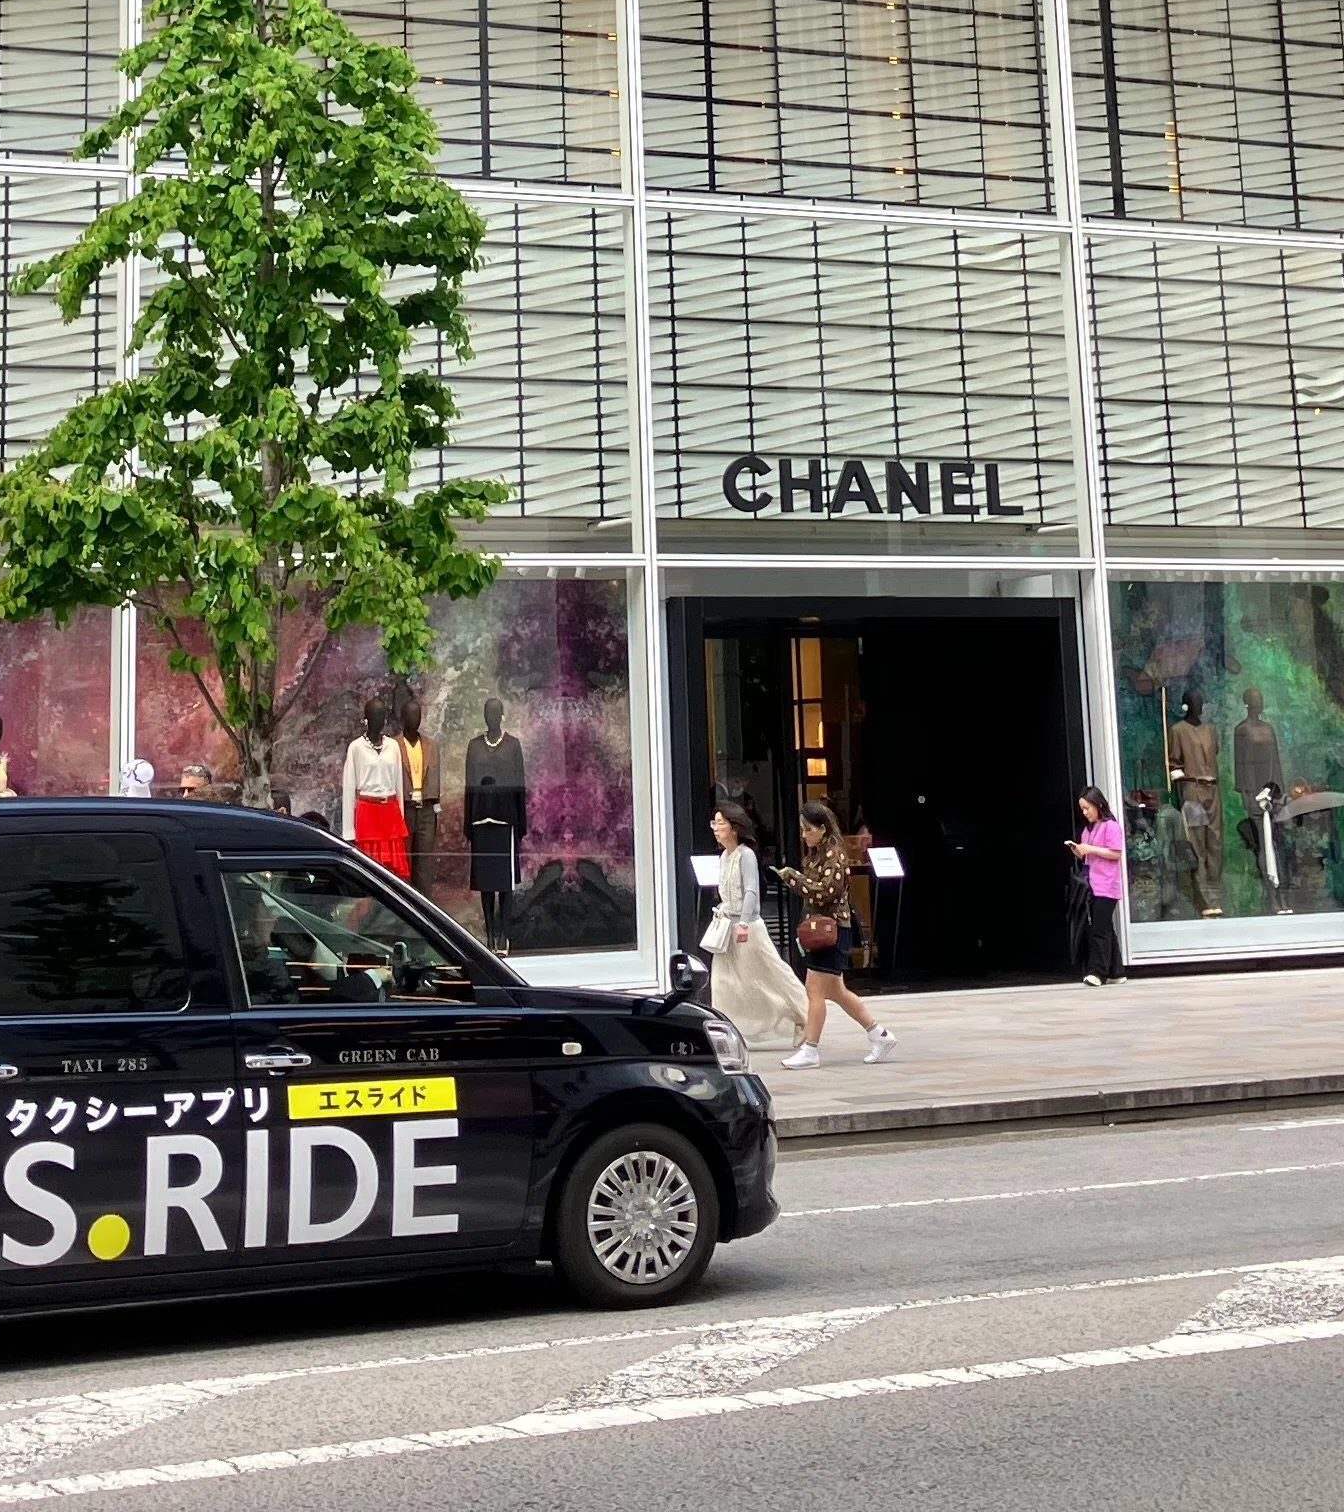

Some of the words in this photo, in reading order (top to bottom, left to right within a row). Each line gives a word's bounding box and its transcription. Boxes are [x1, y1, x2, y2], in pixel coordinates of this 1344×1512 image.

[723, 455, 1024, 516] CHANEL
[61, 1059, 104, 1074] TAXI
[117, 1057, 148, 1072] 285
[338, 1049, 397, 1064] GREEN
[406, 1047, 440, 1062] CAB
[6, 1086, 271, 1138] タクシーアプリ
[319, 1084, 428, 1111] エスライド
[2, 1117, 459, 1267] S.RIDE
